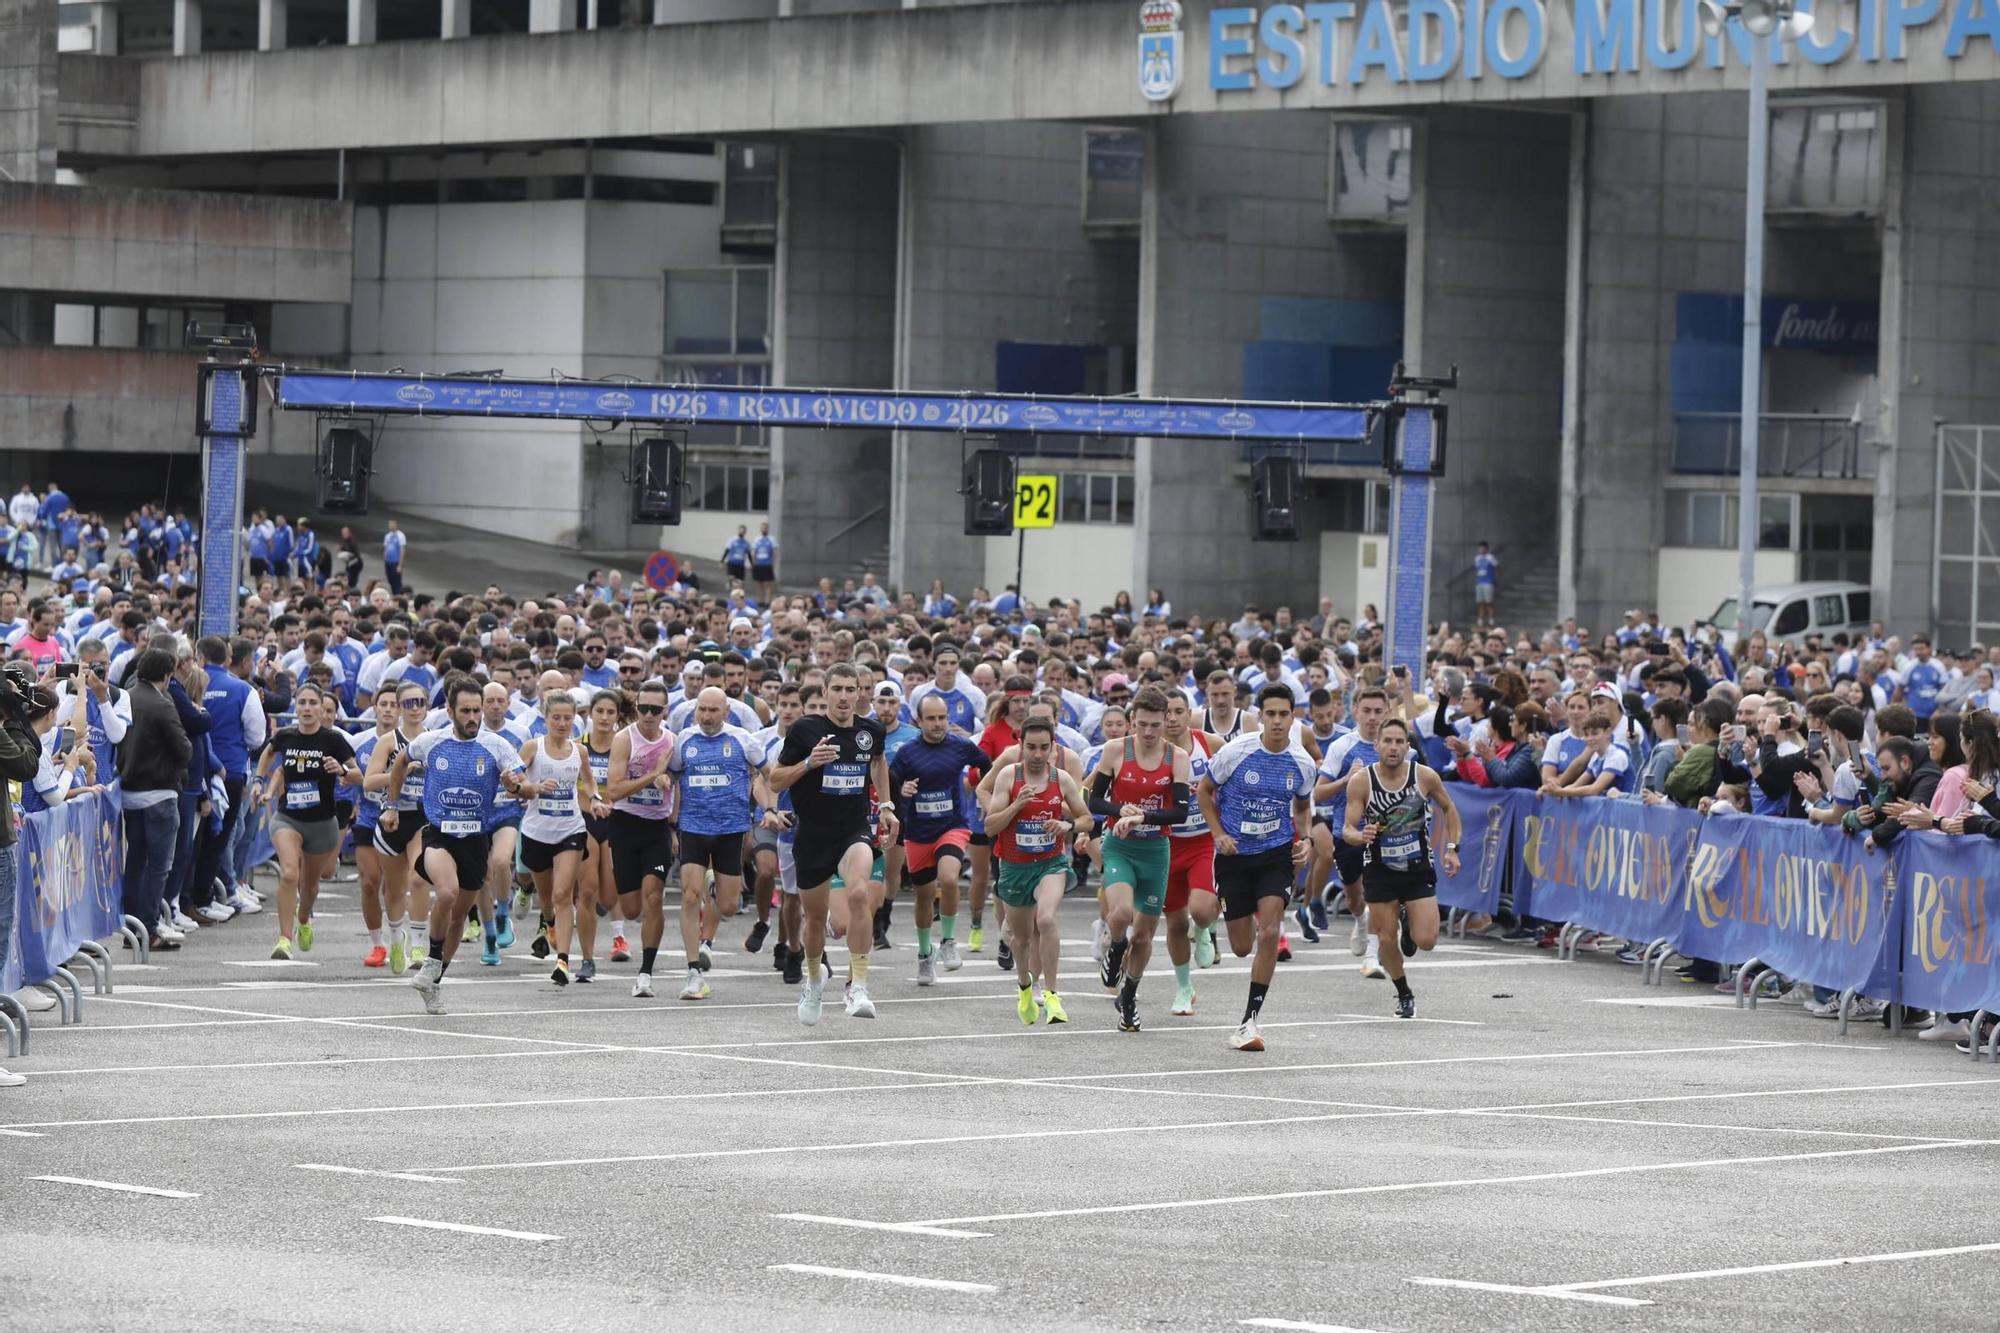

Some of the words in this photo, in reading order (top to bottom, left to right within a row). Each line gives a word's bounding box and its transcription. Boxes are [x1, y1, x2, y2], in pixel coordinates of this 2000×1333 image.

[1209, 0, 1546, 90] ESTADIO
[1774, 302, 1845, 347] fondo
[500, 385, 523, 398] DIGI
[650, 393, 707, 417] 1926
[812, 398, 917, 423] OVIEDO
[945, 402, 1010, 426] 2026
[1018, 484, 1051, 519] P2
[1585, 825, 1672, 905] OVIEDO
[1684, 843, 1770, 929] REAL
[1774, 853, 1868, 946] OVIEDO
[1911, 871, 1992, 973] REAL
